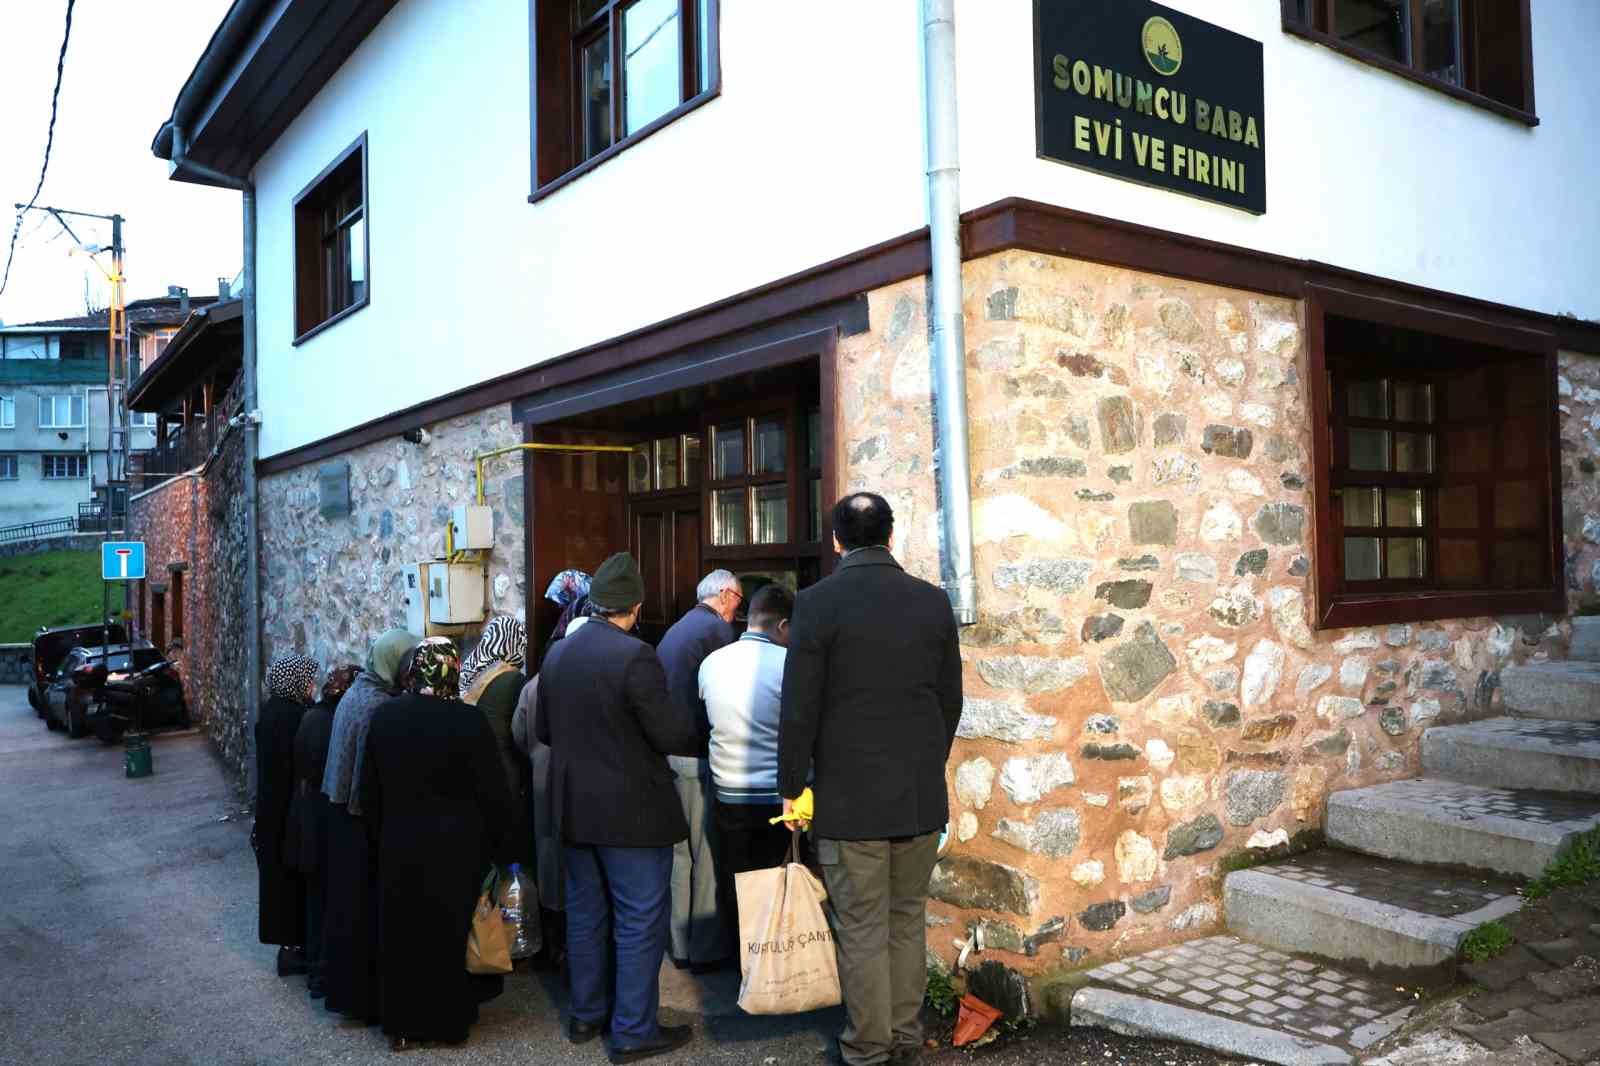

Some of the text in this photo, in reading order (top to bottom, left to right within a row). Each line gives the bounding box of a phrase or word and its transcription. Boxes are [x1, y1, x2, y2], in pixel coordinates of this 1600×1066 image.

[1053, 54, 1260, 148] SOMUNCU BABA
[1074, 115, 1245, 194] EVİ VE FIRINI
